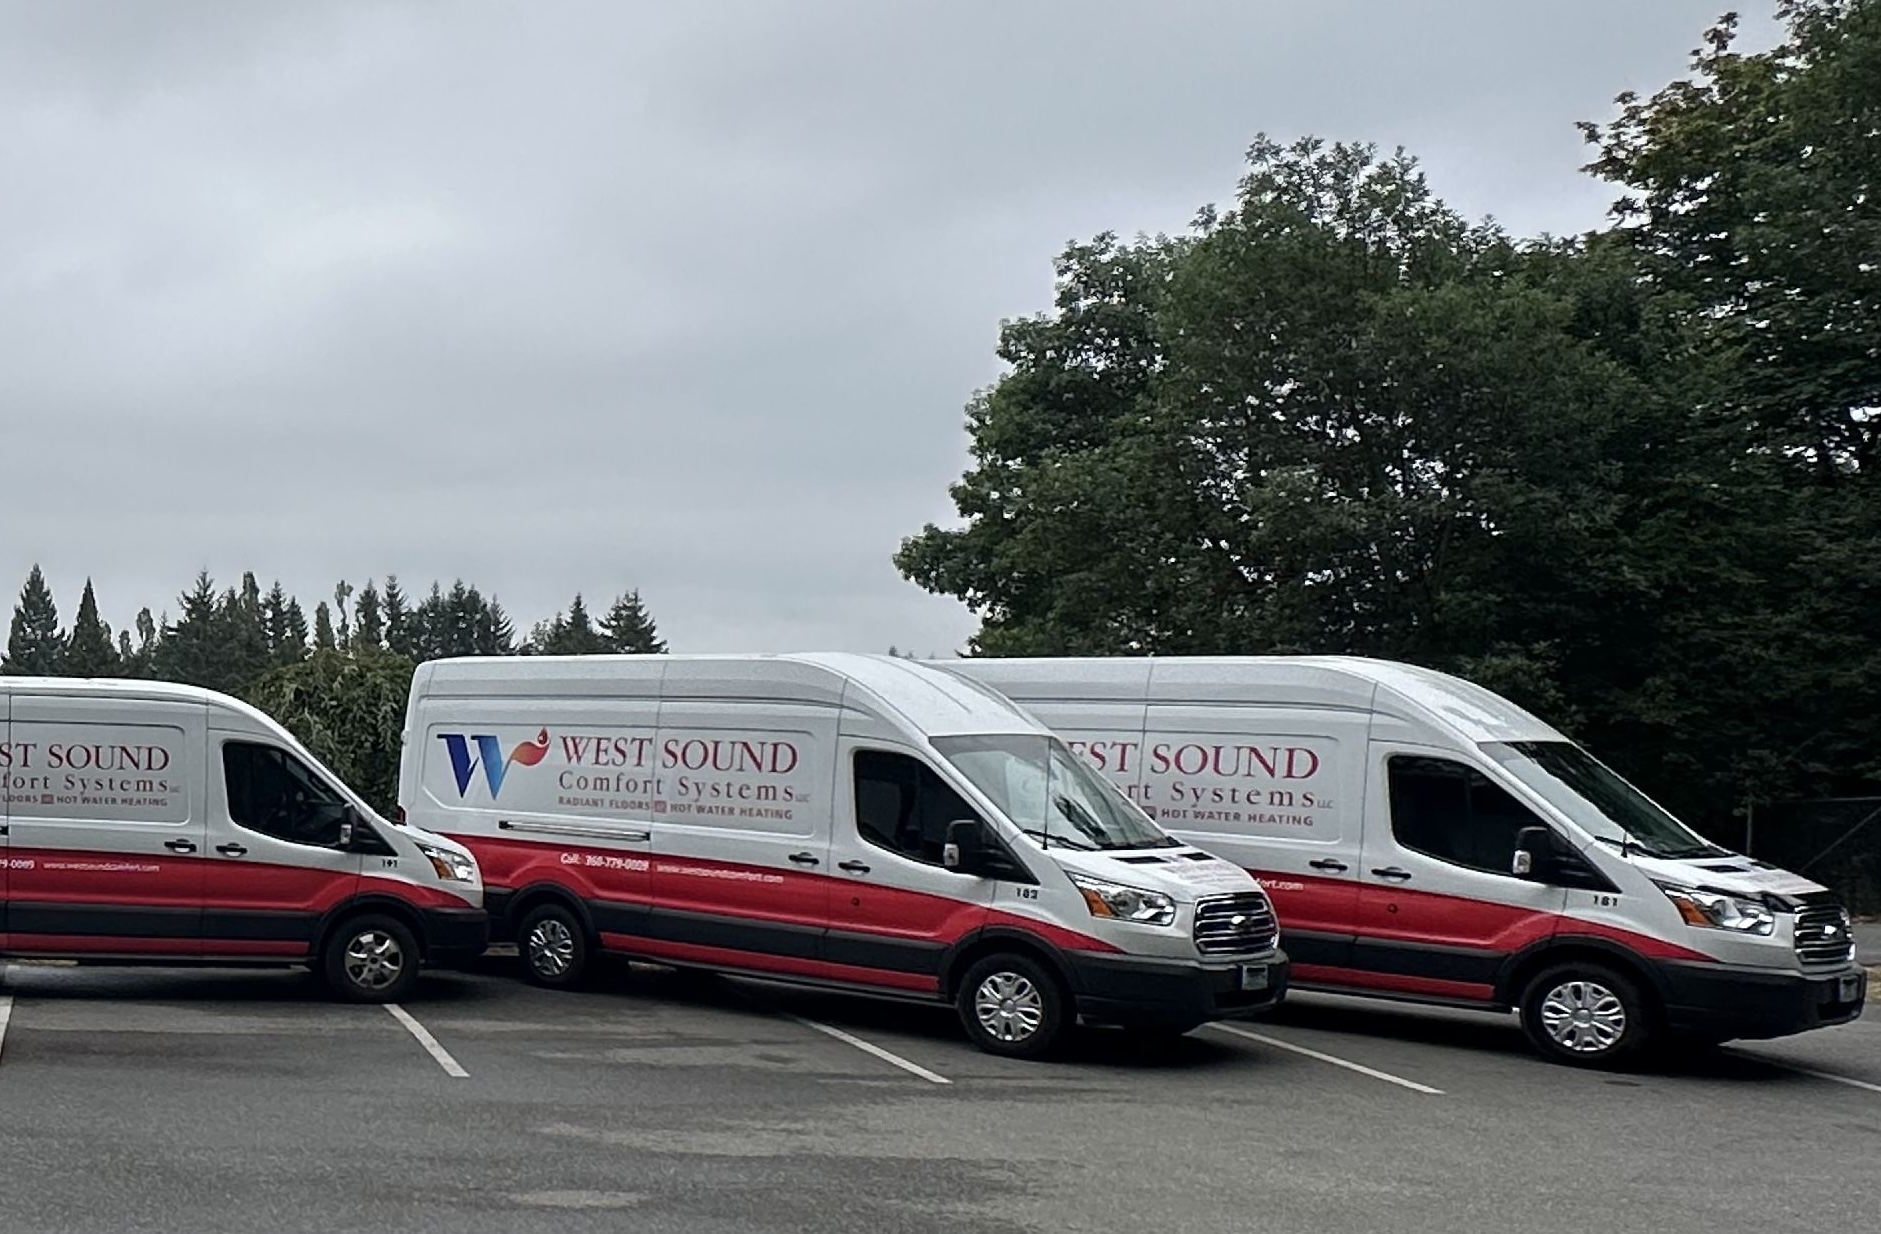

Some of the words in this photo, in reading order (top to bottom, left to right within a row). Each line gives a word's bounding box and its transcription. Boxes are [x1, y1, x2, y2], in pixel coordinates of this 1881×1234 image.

[47, 742, 171, 772] SOUND
[559, 735, 654, 768] WEST
[662, 738, 799, 774] SOUND
[1067, 741, 1138, 772] EST
[1150, 743, 1319, 779] SOUND
[63, 774, 168, 795] Systems
[559, 771, 663, 795] Comfort
[678, 776, 794, 802] Systems
[1171, 781, 1315, 808] Systems
[57, 796, 78, 804] HOT
[82, 796, 117, 805] WATER
[121, 797, 168, 807] HEATING
[558, 796, 605, 807] RADIANT
[609, 799, 650, 811] FLOORS
[670, 802, 692, 813] HOT
[696, 804, 735, 816] WATER
[739, 807, 793, 820] HEATING
[1162, 809, 1187, 818] HOT
[1193, 810, 1241, 822] WATER
[1248, 814, 1314, 826] HEATING
[1593, 895, 1618, 907] 181
